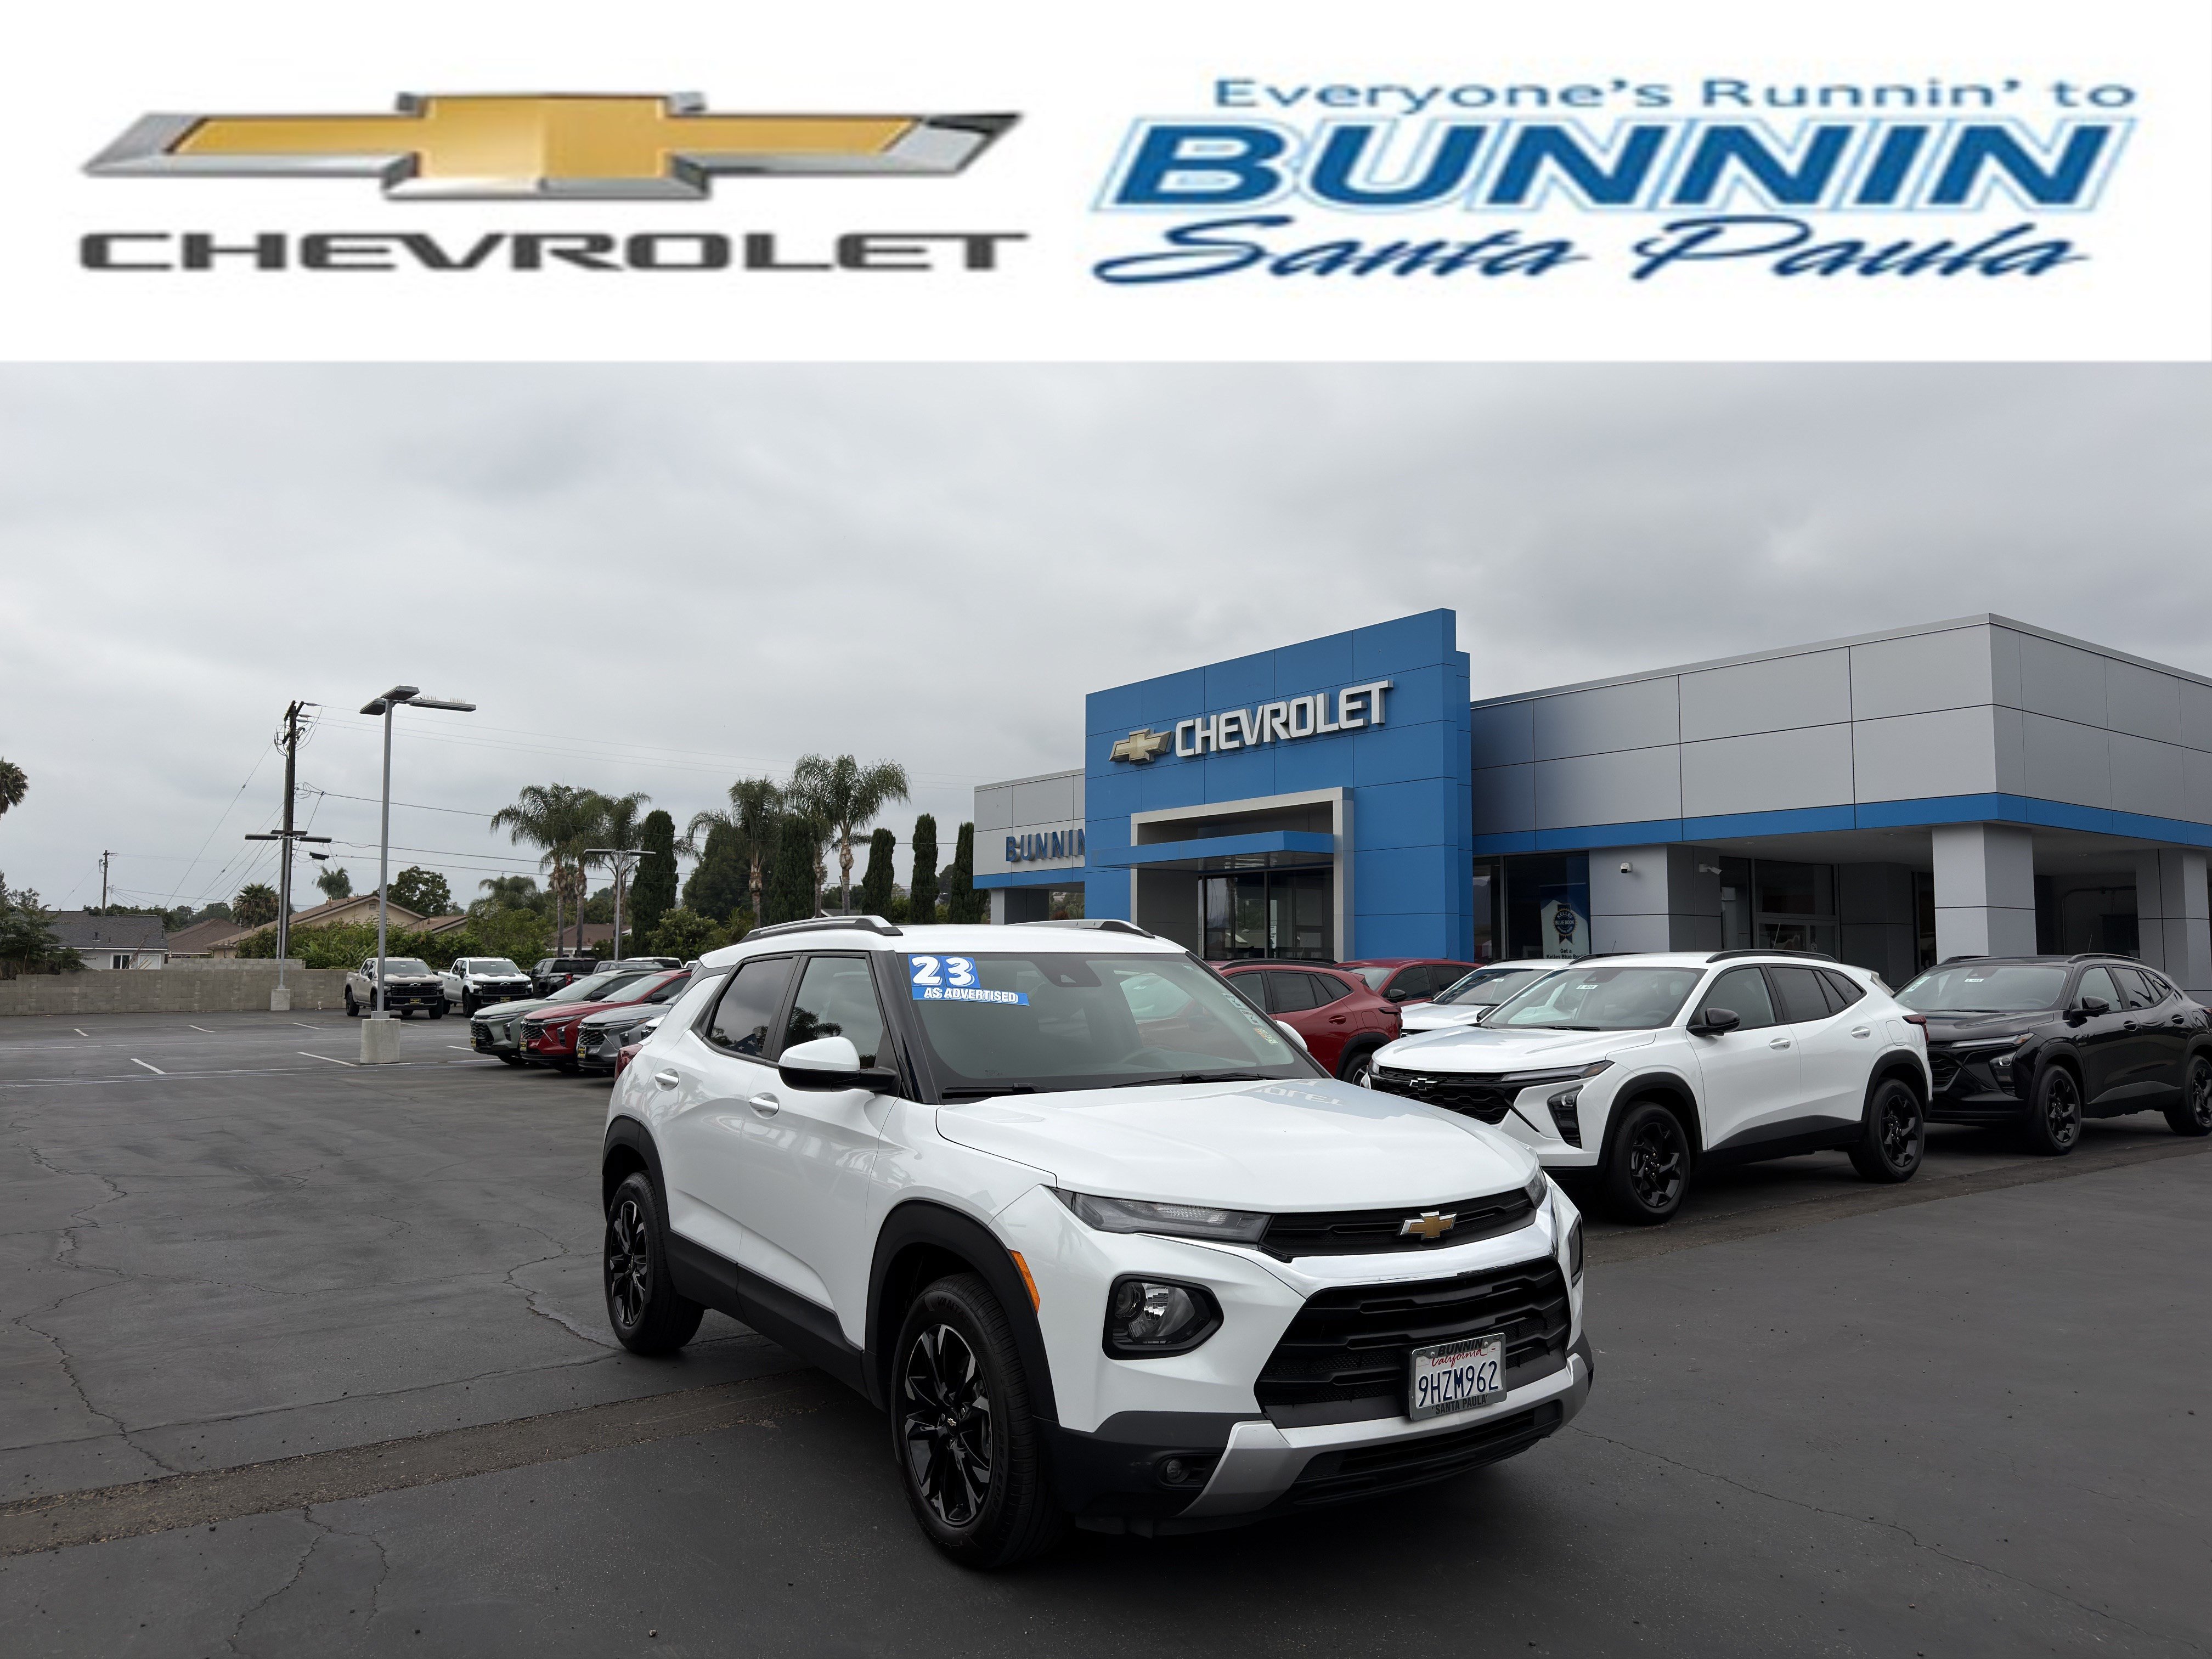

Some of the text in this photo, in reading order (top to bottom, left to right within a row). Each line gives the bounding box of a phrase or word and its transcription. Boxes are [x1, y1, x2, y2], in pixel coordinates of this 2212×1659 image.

[1175, 680, 1394, 757] CHEVROLET
[911, 956, 975, 987] 23
[924, 987, 1018, 1003] AS ADVERTISED
[1437, 1338, 1483, 1357] BUNNIN
[1431, 1348, 1487, 1368] California
[1419, 1361, 1498, 1407] 9HZM962
[1435, 1395, 1487, 1415] SANTA PAULA
